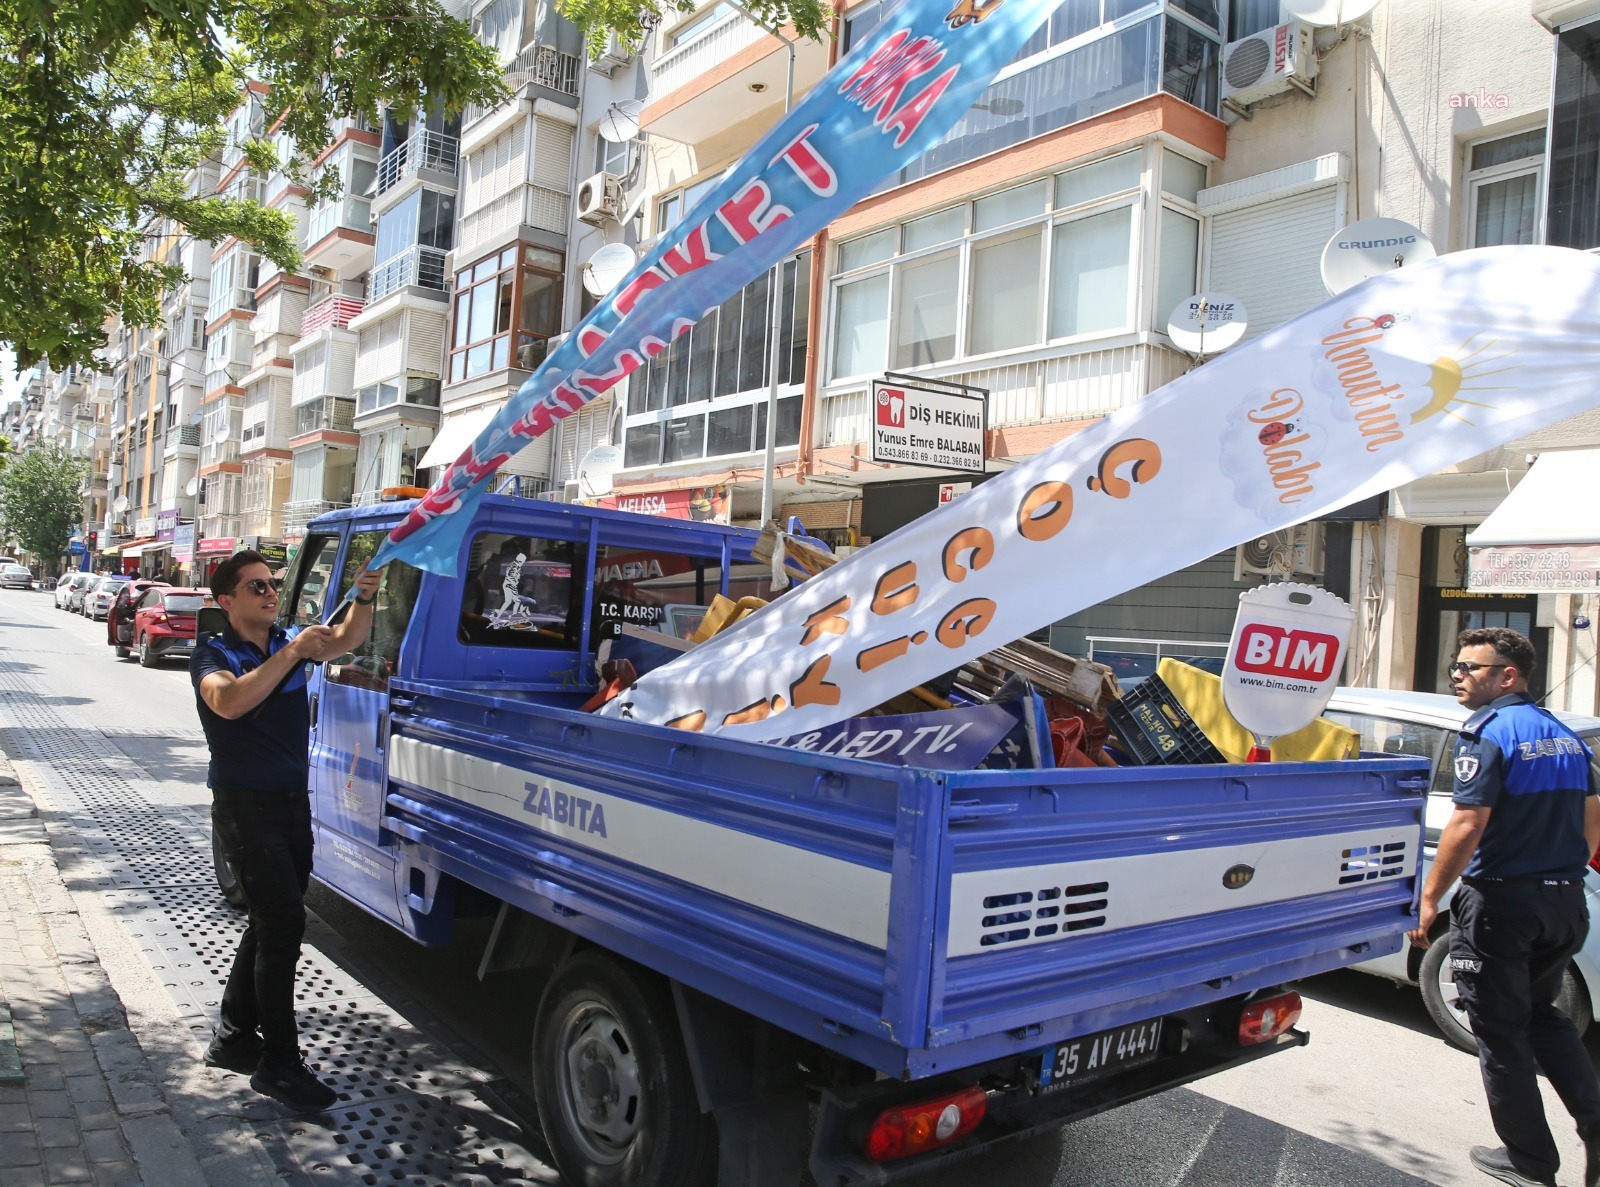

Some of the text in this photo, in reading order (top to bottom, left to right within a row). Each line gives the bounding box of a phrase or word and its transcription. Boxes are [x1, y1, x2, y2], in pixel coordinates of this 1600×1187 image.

[1274, 25, 1287, 74] VESTEL
[1338, 235, 1416, 250] GRUNDIG
[909, 403, 980, 429] DİŞ HEKİMİ
[877, 429, 980, 455] Yunus Emre BALABAN
[878, 446, 909, 459] 0.543.866
[911, 451, 919, 460] 83
[920, 452, 928, 461] 69
[933, 454, 963, 466] 0.232.366
[963, 457, 971, 467] 82
[972, 458, 980, 468] 94
[617, 493, 667, 515] MELİSSA
[1488, 552, 1506, 569] TEL
[1515, 552, 1536, 569] 367
[1538, 552, 1553, 568] 22
[1555, 551, 1571, 568] 48
[1470, 570, 1493, 586] GSM
[1501, 570, 1531, 586] 0.555
[1533, 570, 1555, 587] 608
[1557, 570, 1572, 587] 12
[1575, 570, 1590, 587] 98
[600, 602, 621, 617] T.C.
[1240, 677, 1318, 694] www.bim.com.tr
[1140, 703, 1176, 752] HAL NO 48
[819, 729, 903, 758] LED
[898, 722, 974, 756] TV.
[1517, 737, 1585, 761] ZABITA
[523, 781, 608, 839] ZABITA
[1450, 958, 1477, 971] ABITA
[1054, 1021, 1158, 1079] 35 AV 4441
[1042, 1068, 1052, 1077] TR
[1041, 1079, 1071, 1095] ARKAS
